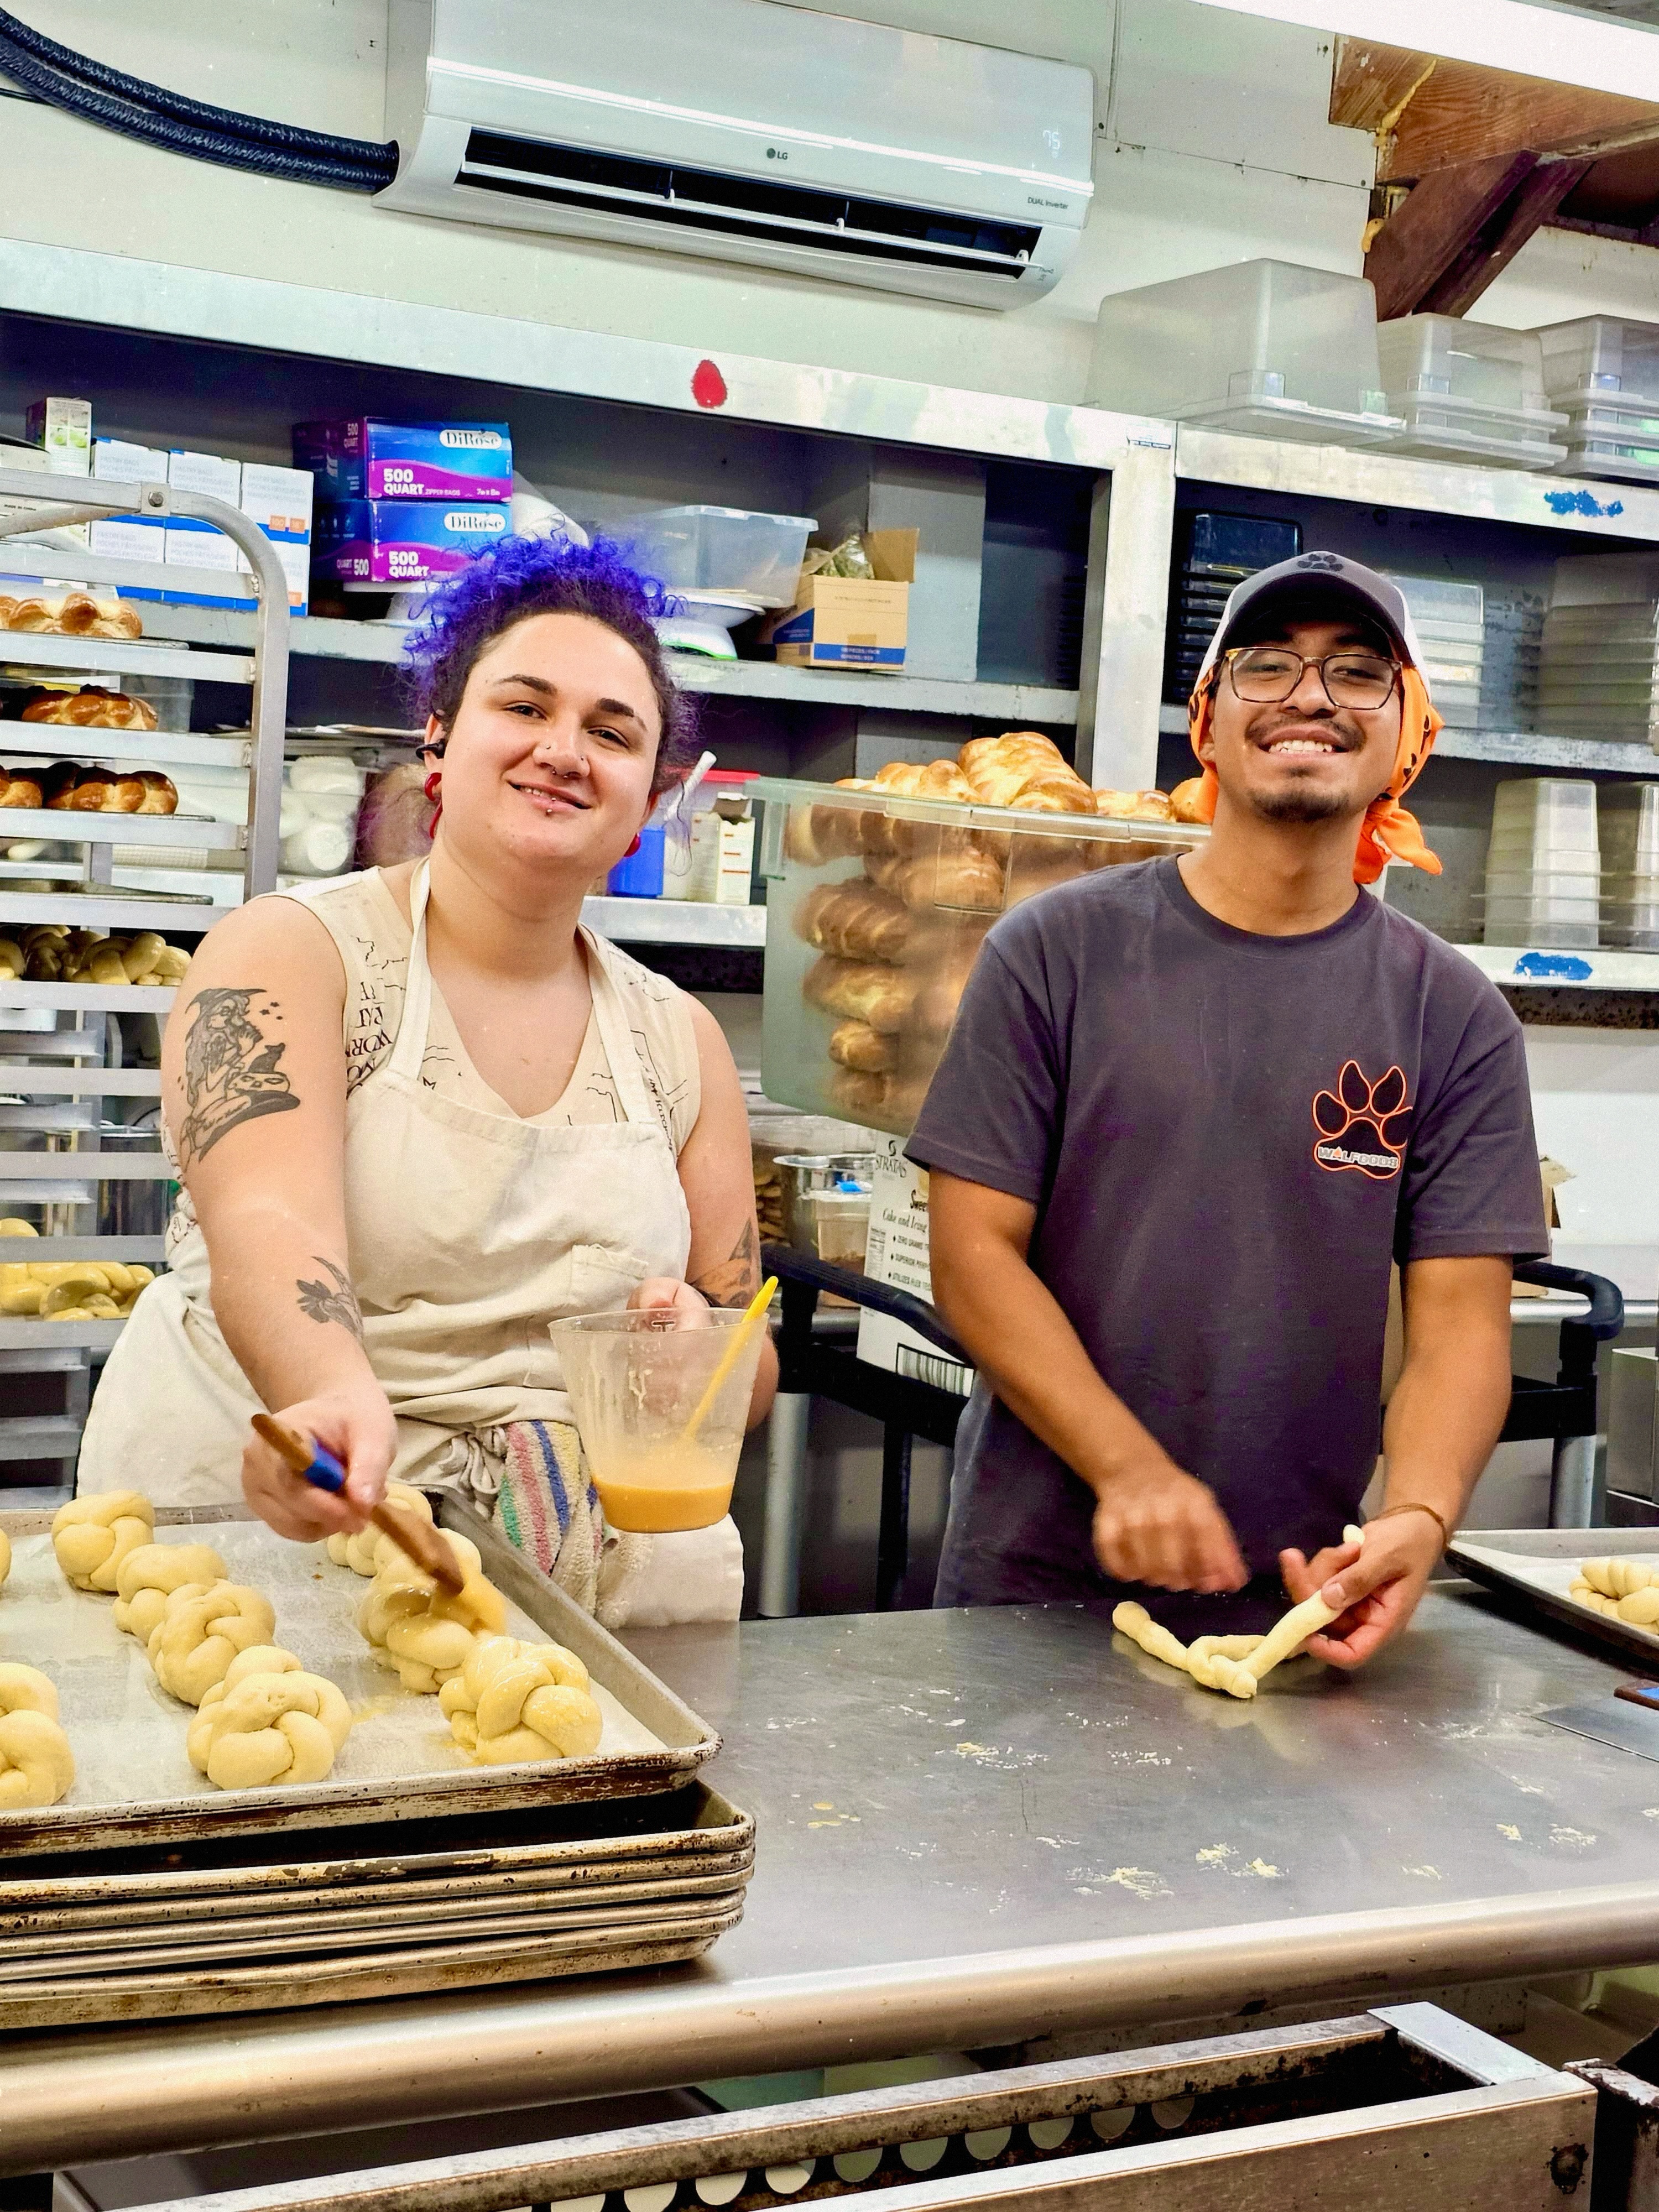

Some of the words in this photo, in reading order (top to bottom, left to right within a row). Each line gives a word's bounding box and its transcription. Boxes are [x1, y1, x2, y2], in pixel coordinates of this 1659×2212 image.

[777, 151, 788, 160] LG
[1027, 197, 1044, 206] DUAL
[1046, 200, 1068, 209] Inverter
[347, 422, 358, 436] 500
[446, 431, 498, 445] DiRose
[384, 468, 414, 483] 500
[384, 483, 425, 495] QUART
[451, 515, 502, 529] DiRose
[389, 551, 419, 565] 500
[354, 559, 369, 576] 500
[389, 566, 430, 578] QUART
[898, 1215, 909, 1228] and
